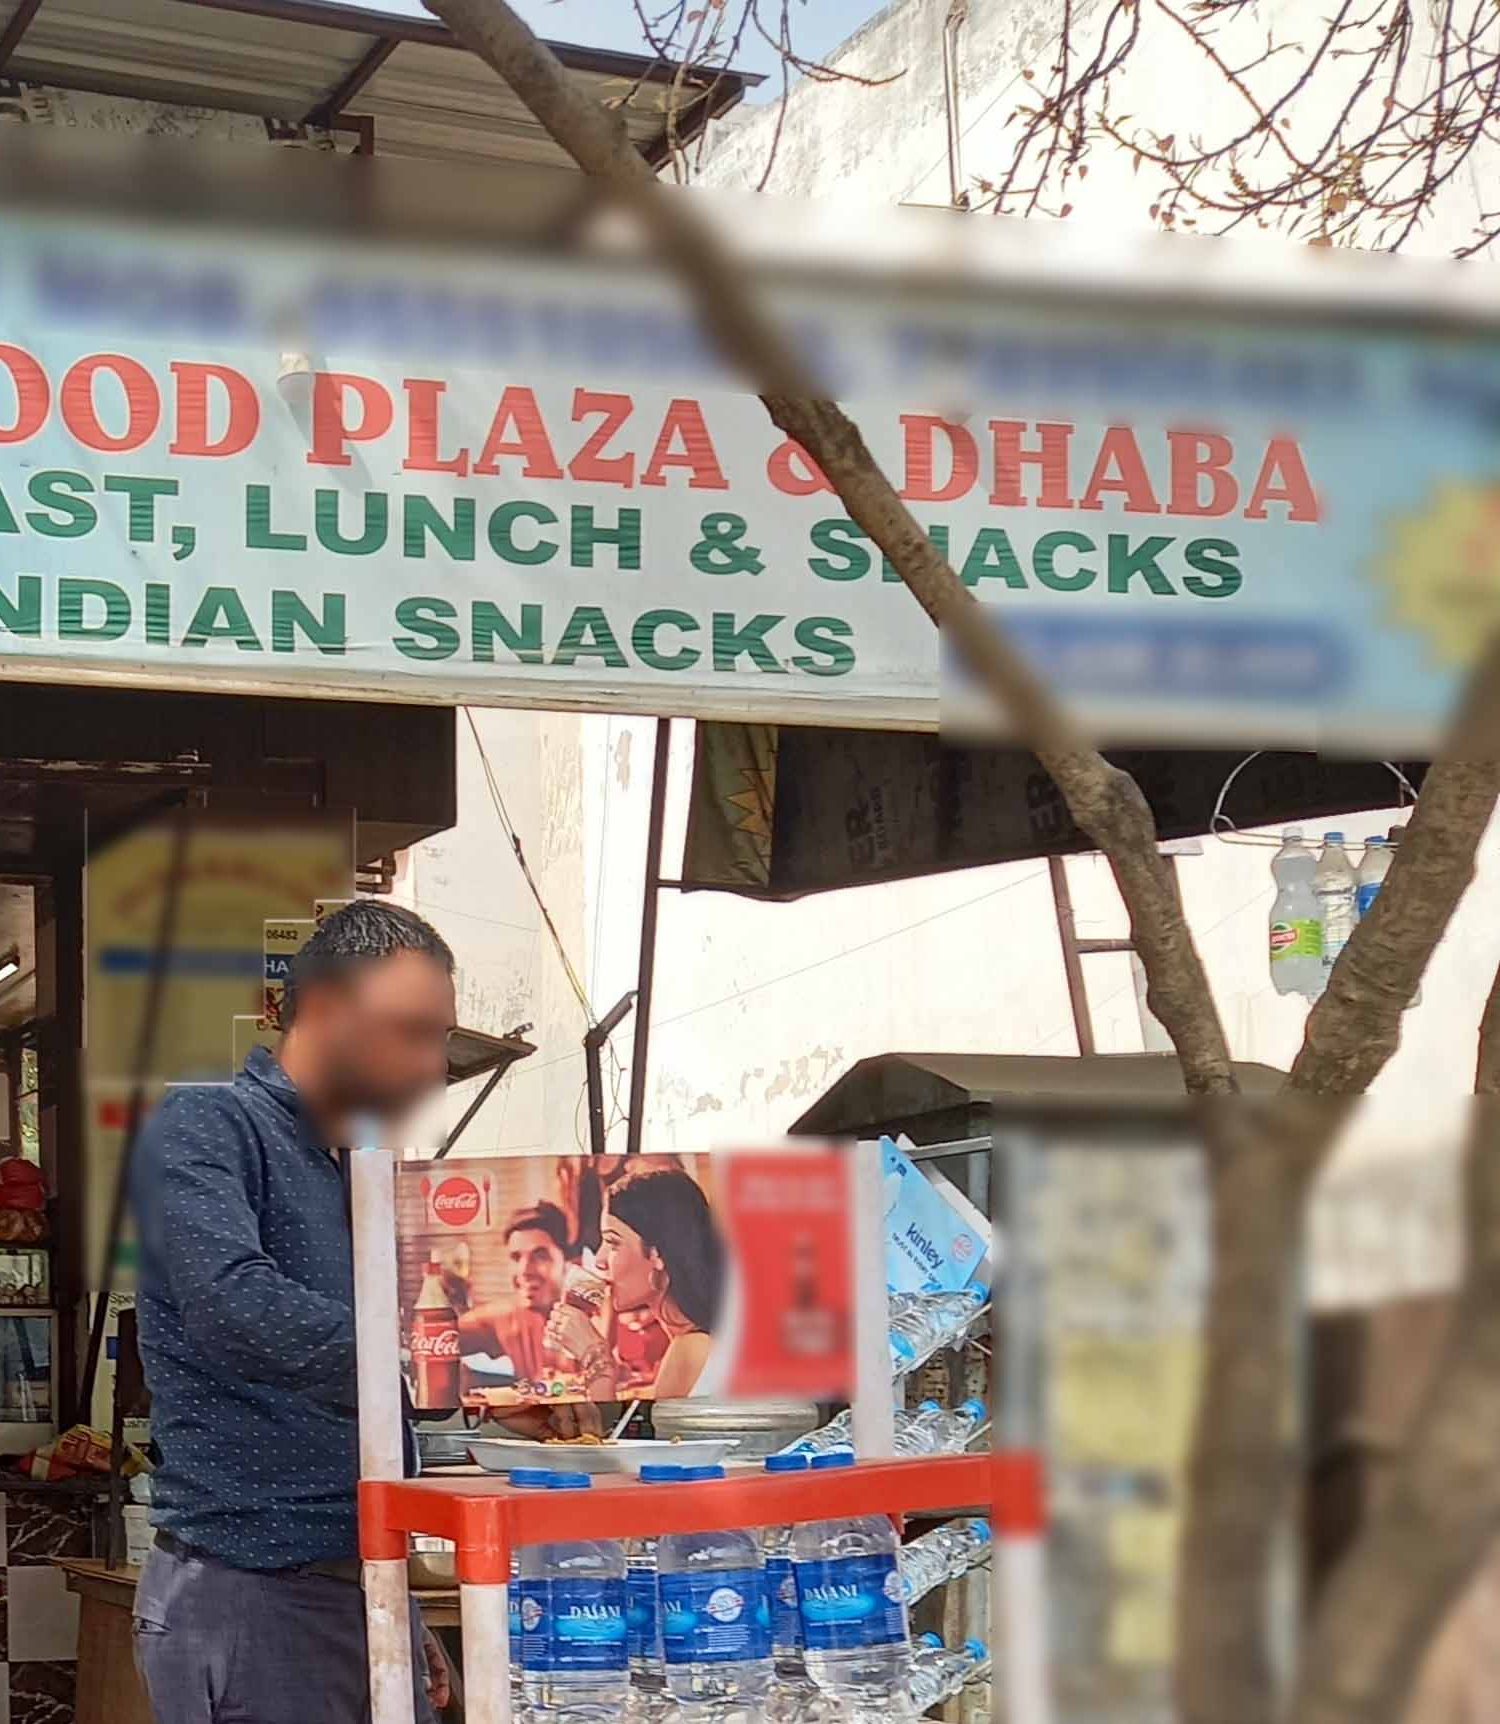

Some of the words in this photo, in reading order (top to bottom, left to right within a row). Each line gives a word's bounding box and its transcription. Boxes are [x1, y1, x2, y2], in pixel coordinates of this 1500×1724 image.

[306, 373, 729, 489] PLAZA
[898, 414, 1321, 523] DHABA
[245, 484, 642, 570] LUNCH
[690, 512, 766, 575] &
[391, 596, 855, 677] SNACKS
[905, 1221, 944, 1271] kinley
